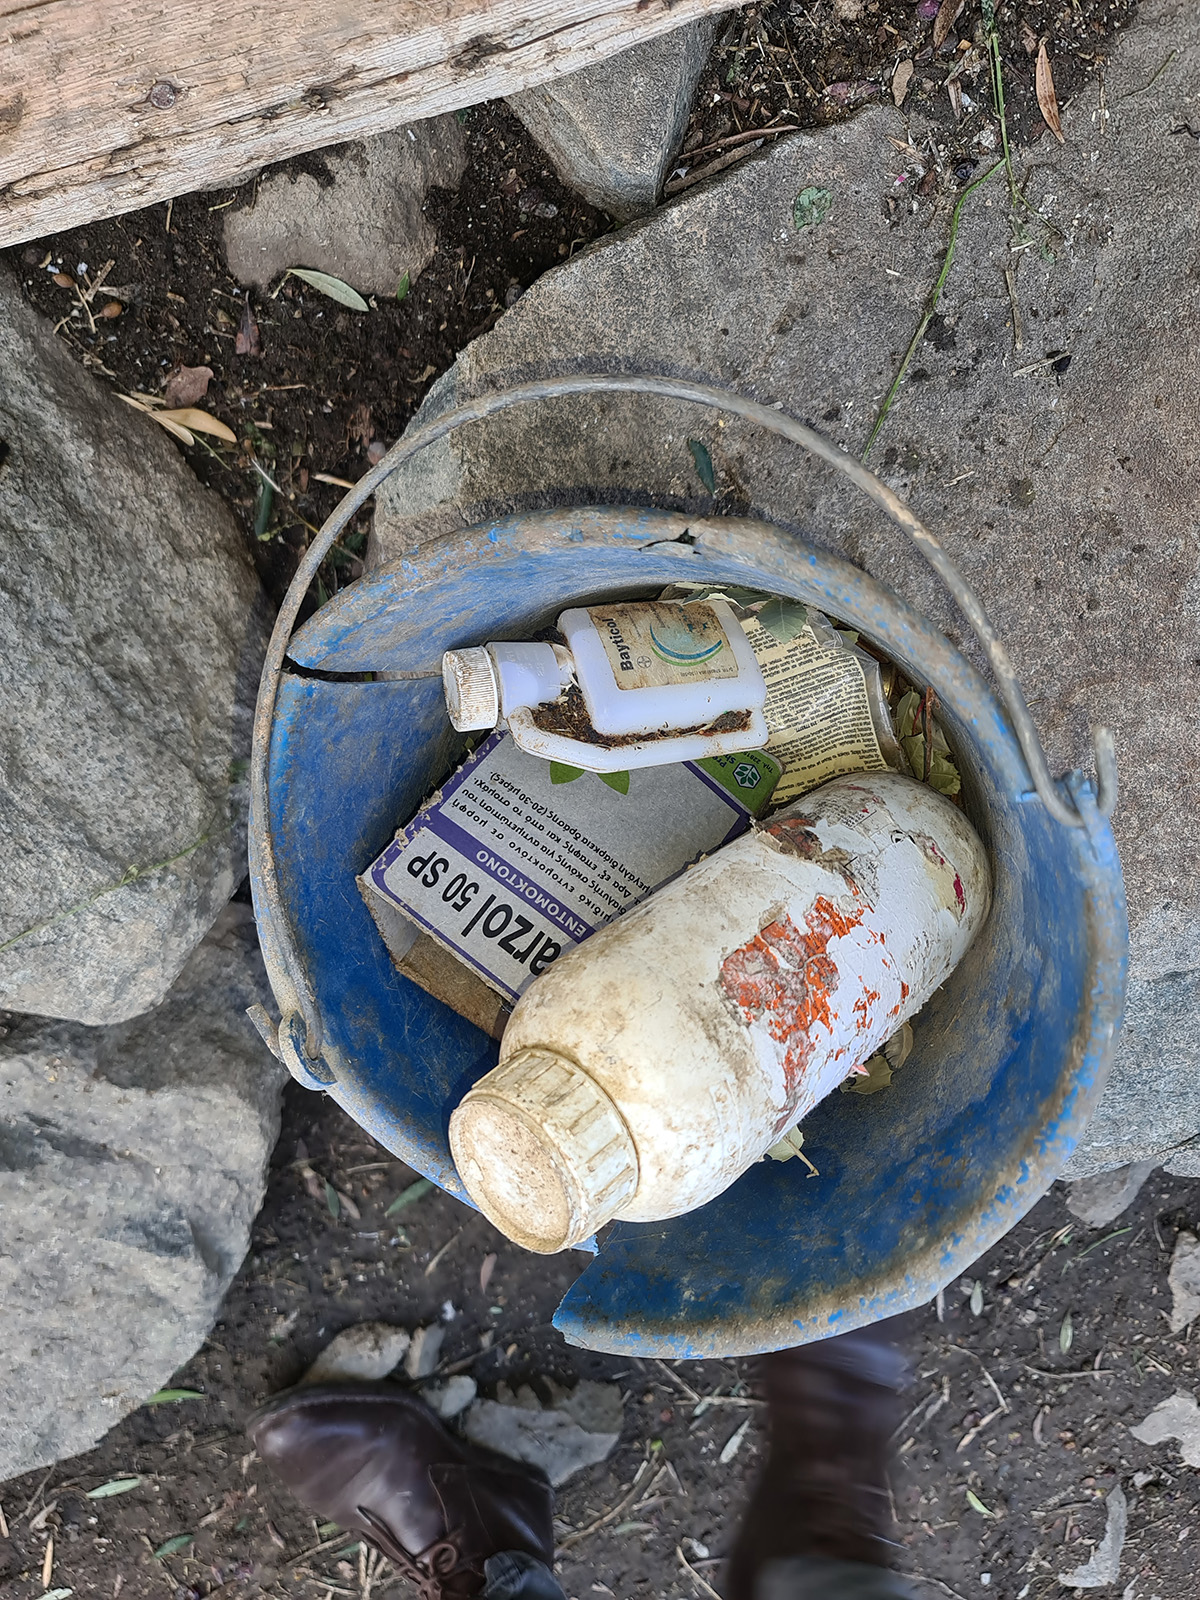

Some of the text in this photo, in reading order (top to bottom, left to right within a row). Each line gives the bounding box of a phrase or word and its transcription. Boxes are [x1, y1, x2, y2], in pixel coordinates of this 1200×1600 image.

[601, 617, 634, 671] Bayticol
[711, 756, 727, 768] Pre
[721, 754, 737, 765] Sh
[461, 789, 478, 803] του
[473, 777, 510, 806] στομάχι.
[479, 799, 540, 847] αντιμετώπιση
[512, 806, 523, 816] το
[524, 815, 545, 831] από
[490, 771, 651, 894] μεγάλη διάρκεια δράσης (20-30 μέρες).
[546, 830, 562, 843] και
[451, 798, 616, 924] μιδικό εντομοκτόνο σε μορφή
[540, 845, 555, 858] για
[562, 841, 598, 871] επαφής
[555, 854, 589, 883] σκόνης
[476, 850, 586, 937] ΕΝΤΟΜΟΚΤΟΝΟ
[612, 880, 632, 898] Δρα
[407, 851, 563, 977] arzol 50 SP
